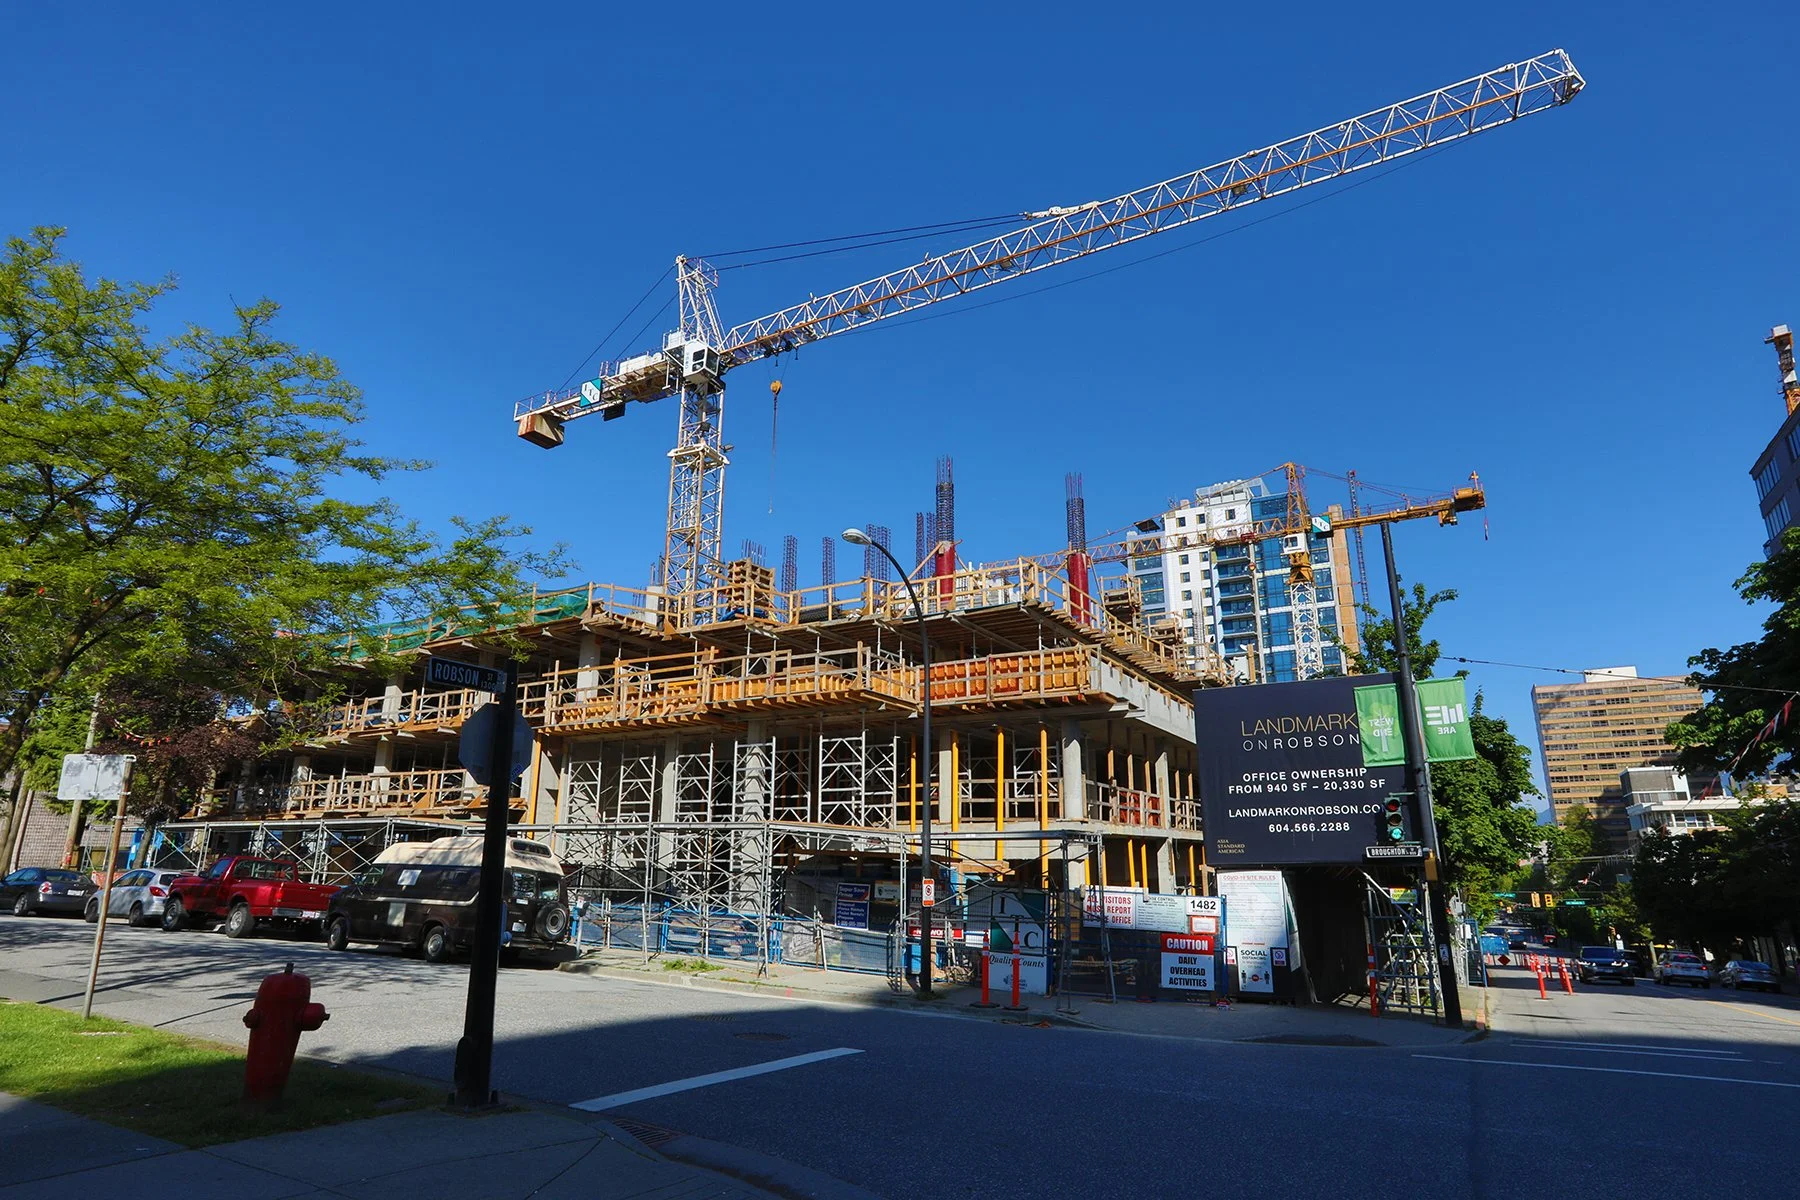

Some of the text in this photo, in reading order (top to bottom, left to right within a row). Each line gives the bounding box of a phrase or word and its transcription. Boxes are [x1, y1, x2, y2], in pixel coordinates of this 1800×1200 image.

[435, 663, 479, 685] ROBSON
[1241, 712, 1358, 737] LANDMARK
[1242, 767, 1367, 782] OFFICE OWNERSHIP
[1228, 784, 1262, 795] FROM
[1266, 783, 1288, 793] 940
[1292, 782, 1308, 792] SF
[1323, 780, 1365, 791] 20,330
[1369, 779, 1386, 789] SF
[1228, 804, 1382, 818] LANDMARKONROBSON.CO
[1268, 822, 1350, 833] 604.566.2288
[1371, 848, 1406, 856] BROUGHTON
[1107, 906, 1131, 914] REPORT
[1190, 900, 1216, 910] 1482
[1112, 916, 1132, 924] OFFICE
[1166, 938, 1208, 950] CAUTION
[1178, 956, 1198, 965] DAILY
[1170, 966, 1206, 976] OVERHEAD
[1169, 977, 1207, 987] ACTIVITIES
